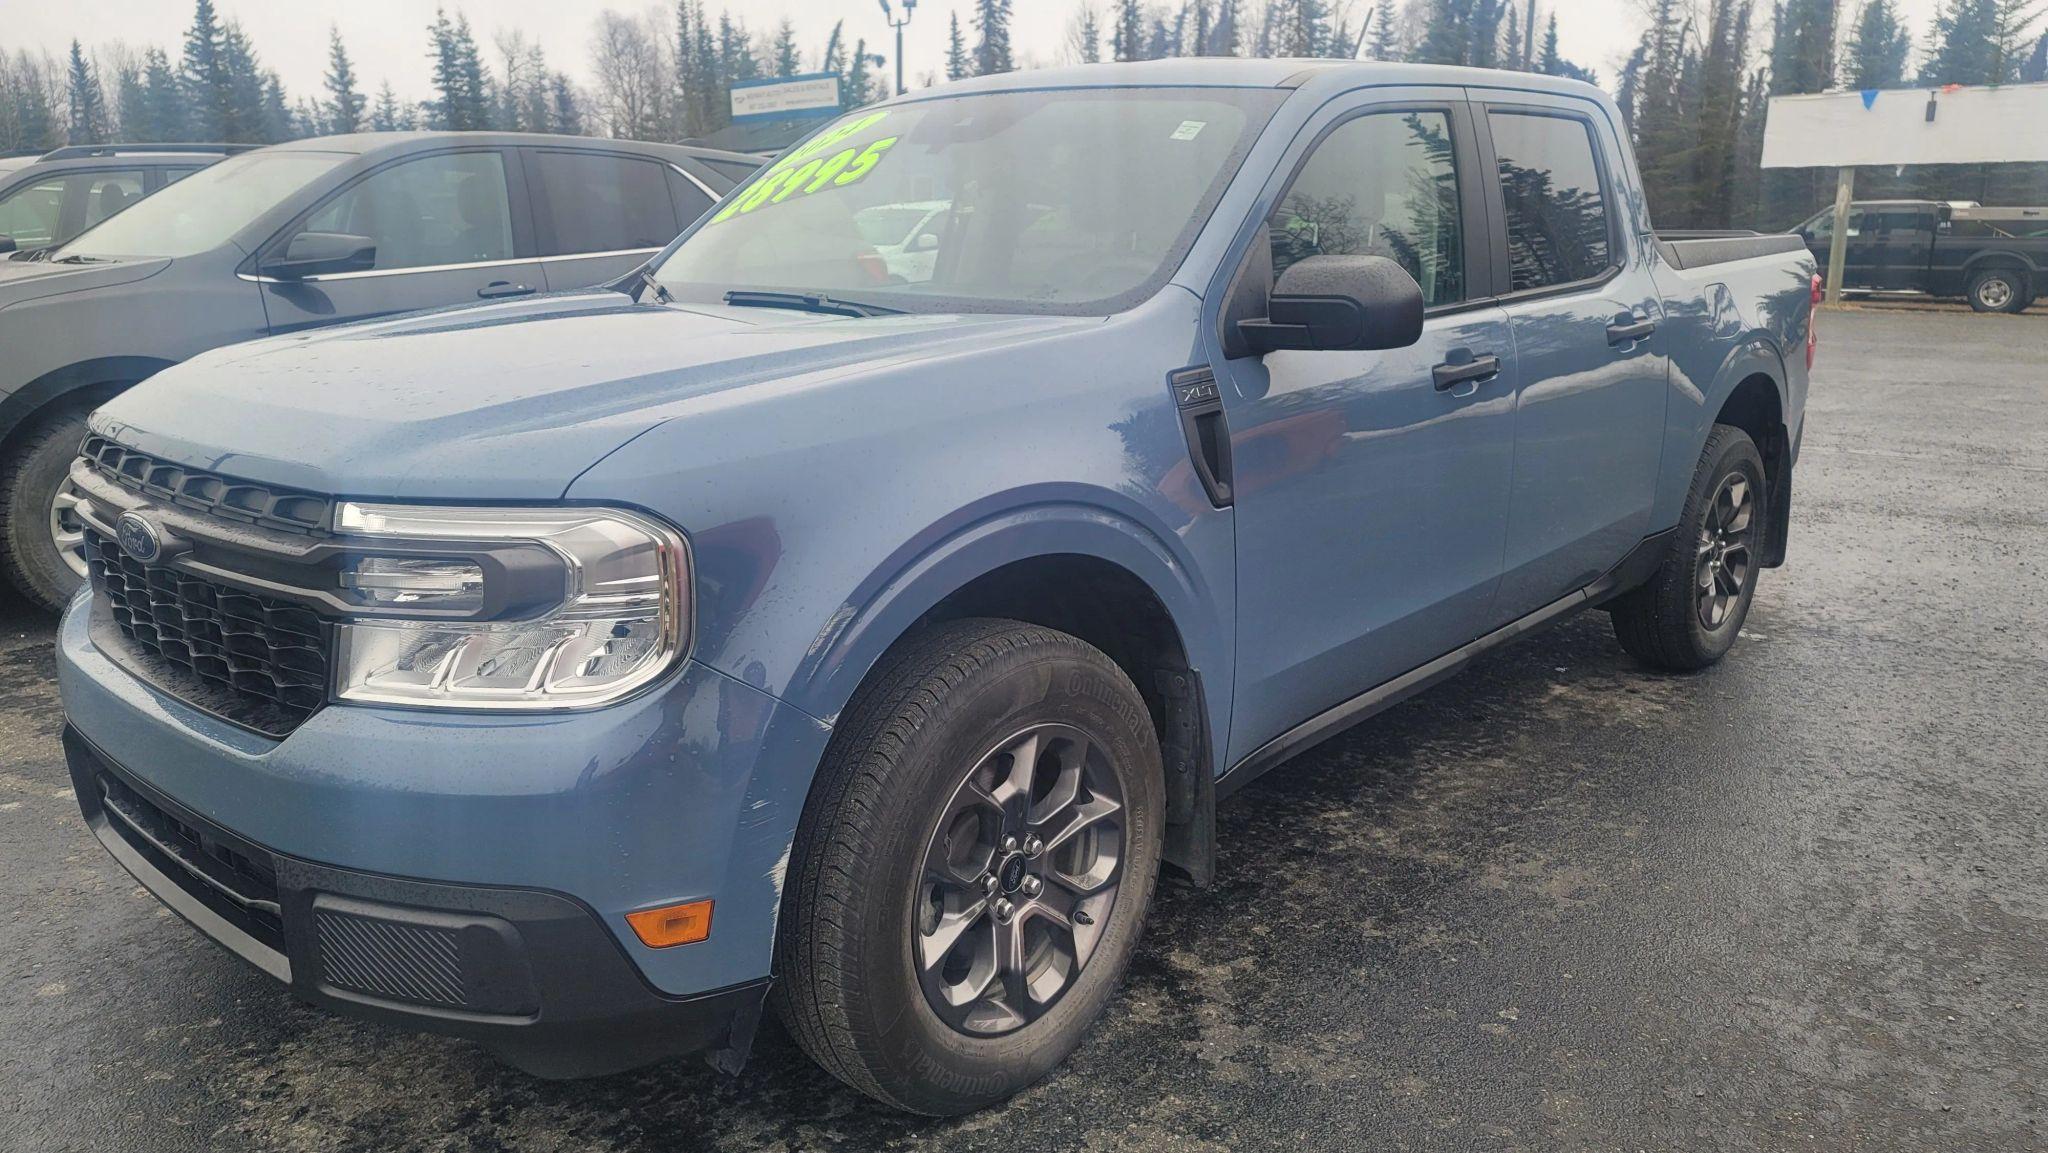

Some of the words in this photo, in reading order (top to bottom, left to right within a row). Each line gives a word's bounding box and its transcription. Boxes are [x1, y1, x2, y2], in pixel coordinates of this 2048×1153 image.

[1182, 384, 1215, 402] XLT
[122, 522, 146, 554] Ford
[1064, 668, 1144, 738] Continental
